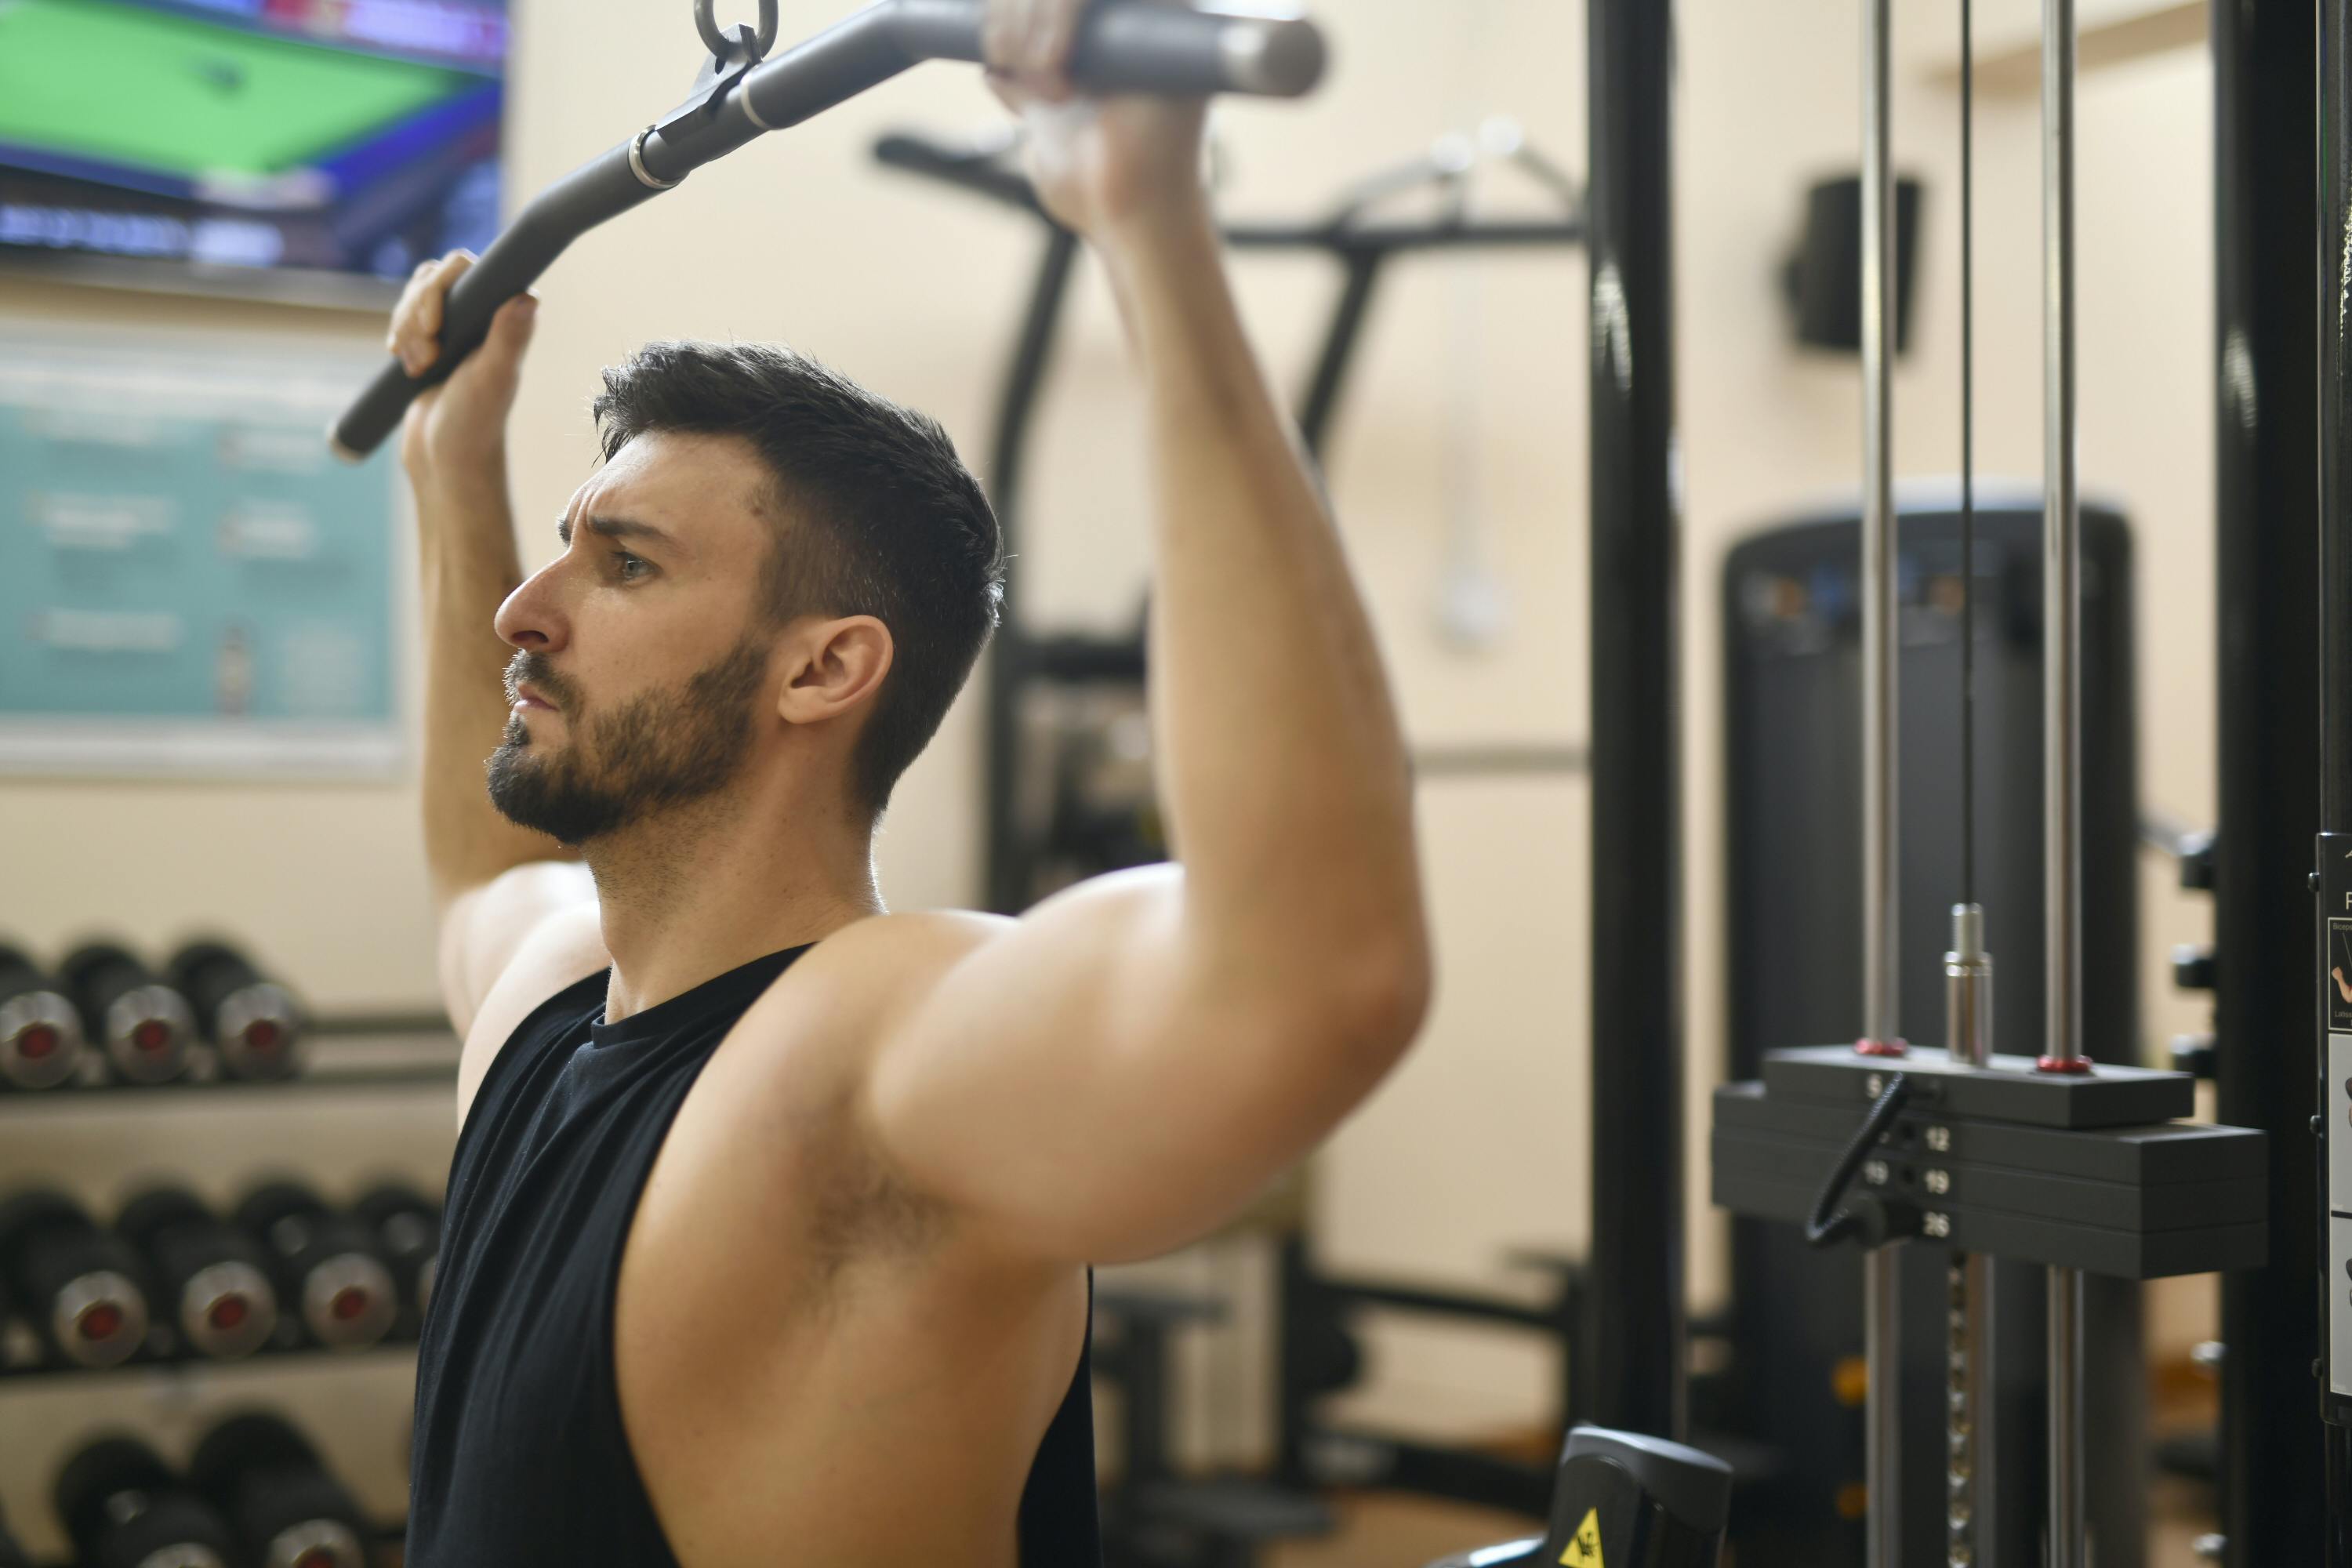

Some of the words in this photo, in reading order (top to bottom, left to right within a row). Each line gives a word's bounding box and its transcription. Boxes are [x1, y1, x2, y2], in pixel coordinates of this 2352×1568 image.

[1926, 1127, 1951, 1152] 12
[1924, 1169, 1950, 1195] 19
[1923, 1211, 1951, 1238] 26
